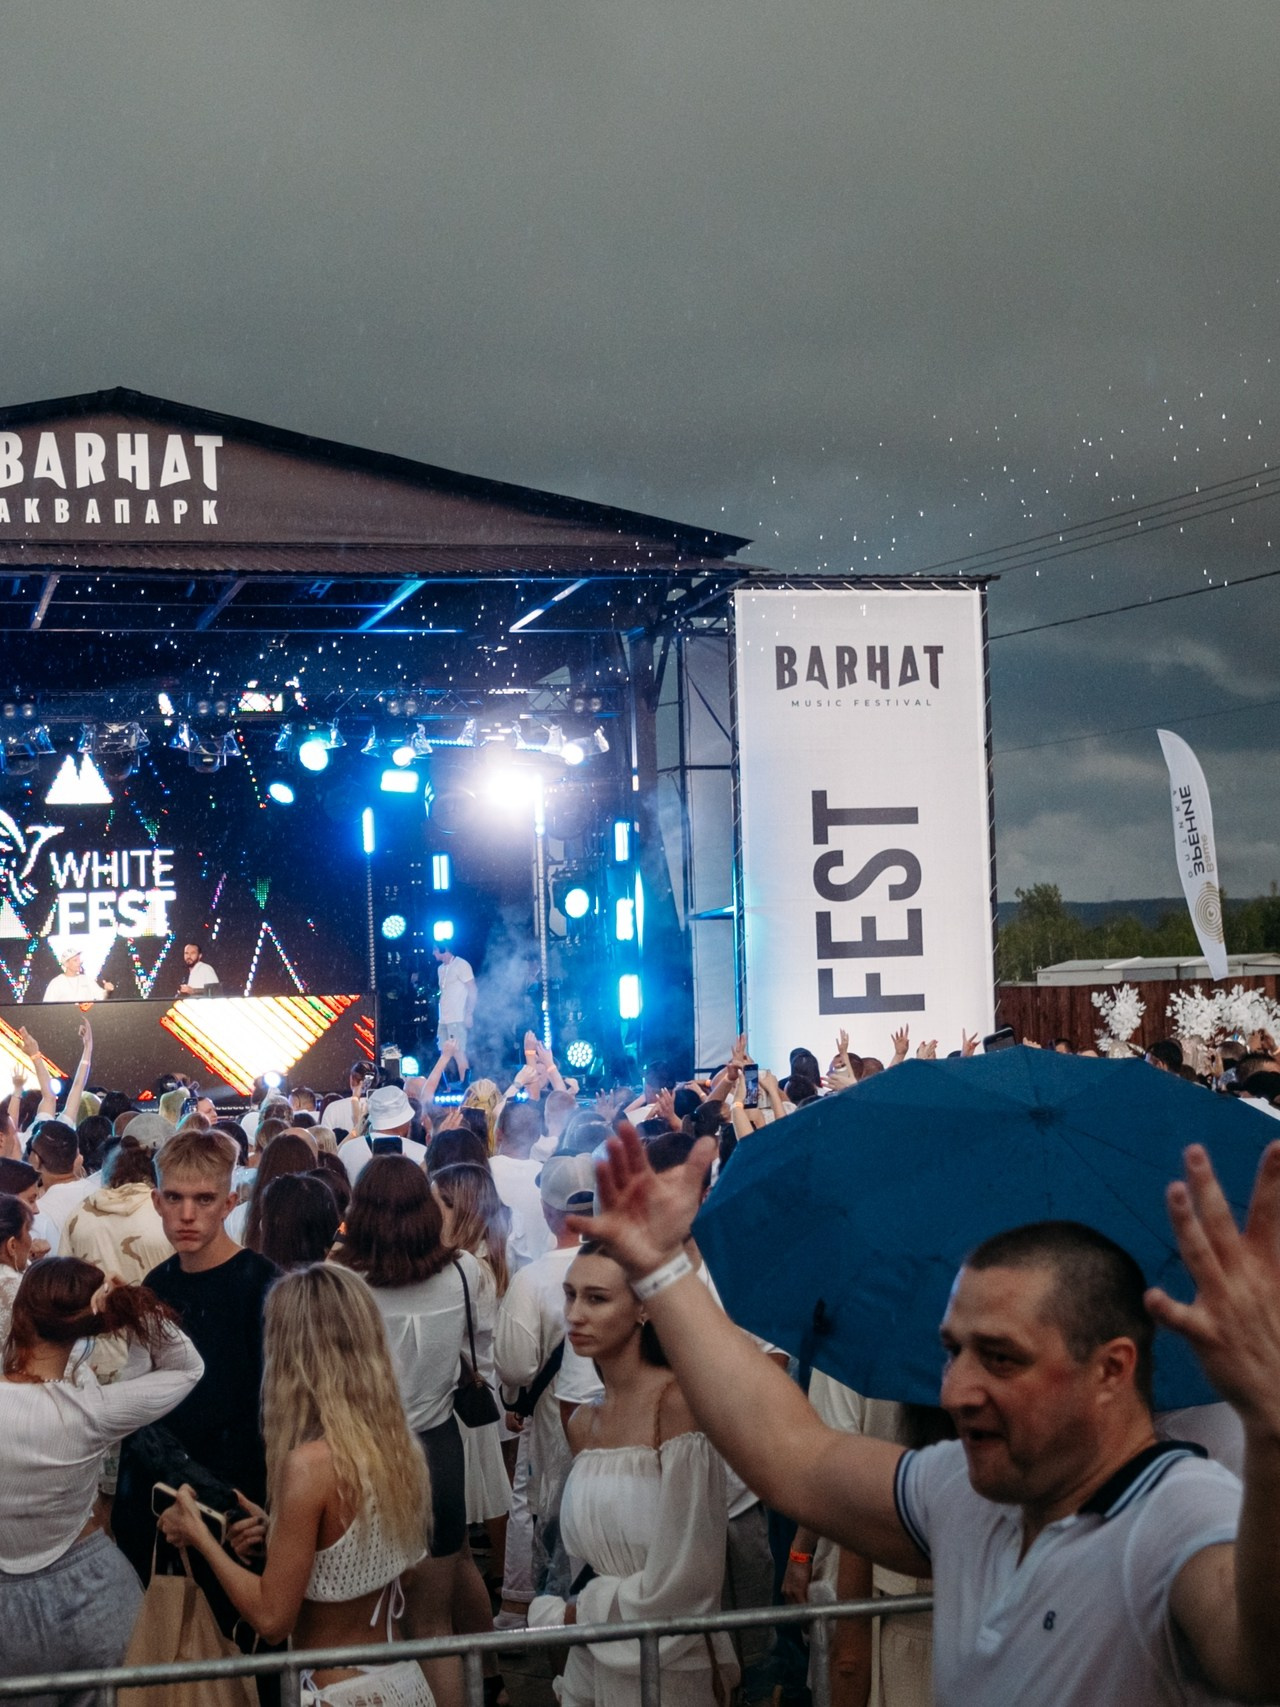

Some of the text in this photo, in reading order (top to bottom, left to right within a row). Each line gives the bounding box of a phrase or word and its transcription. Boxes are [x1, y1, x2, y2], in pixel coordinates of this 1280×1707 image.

[775, 645, 944, 690] BARHAT
[791, 699, 932, 707] MUSIC FESTIVAL
[50, 850, 175, 888] WHITE
[57, 890, 176, 937] FEST
[811, 790, 925, 1015] FEST
